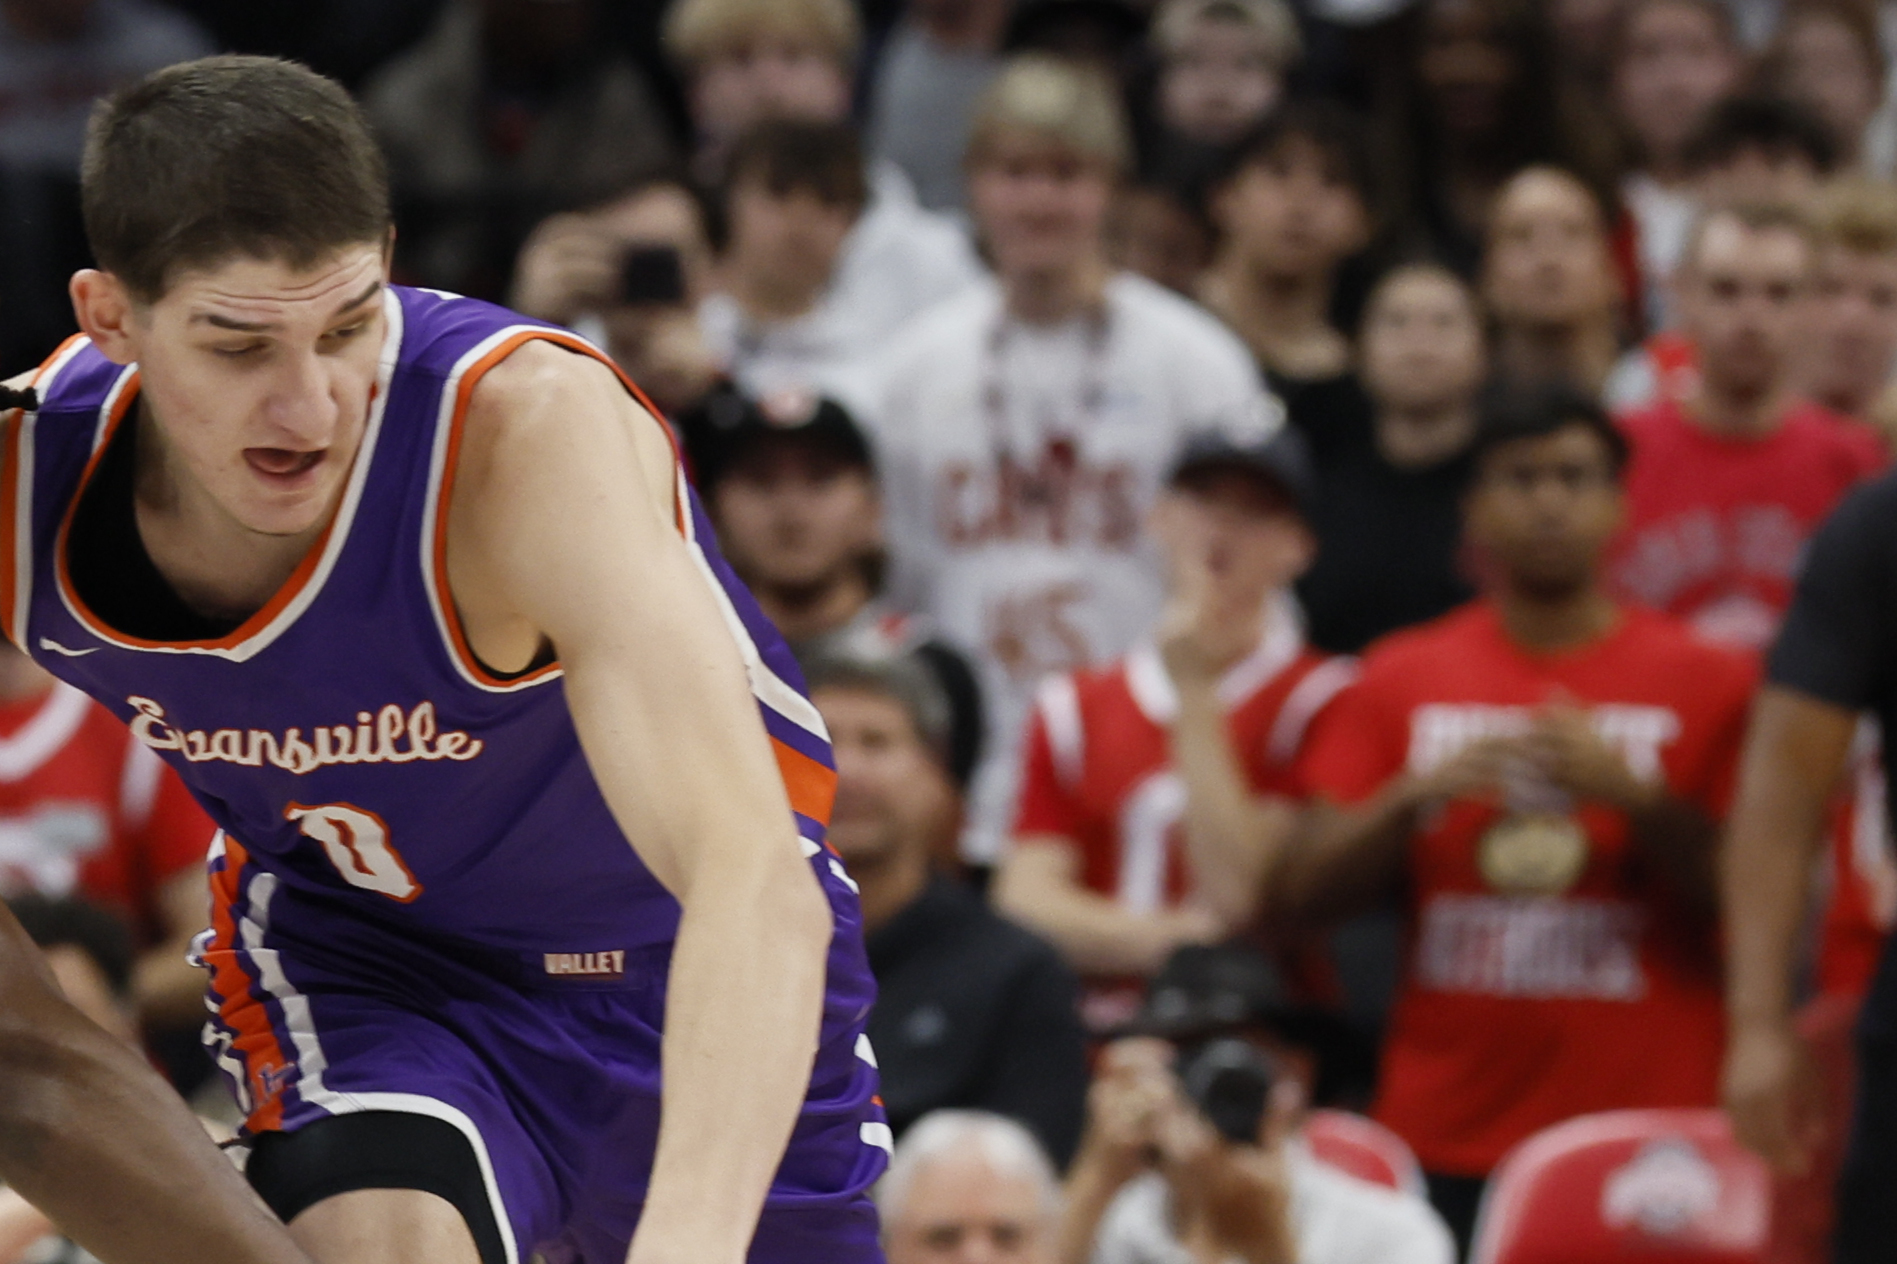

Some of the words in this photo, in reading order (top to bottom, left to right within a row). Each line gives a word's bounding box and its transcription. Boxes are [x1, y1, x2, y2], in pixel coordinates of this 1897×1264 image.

[126, 695, 484, 775] Evansville
[283, 800, 425, 904] 0
[543, 949, 625, 975] VALLEY
